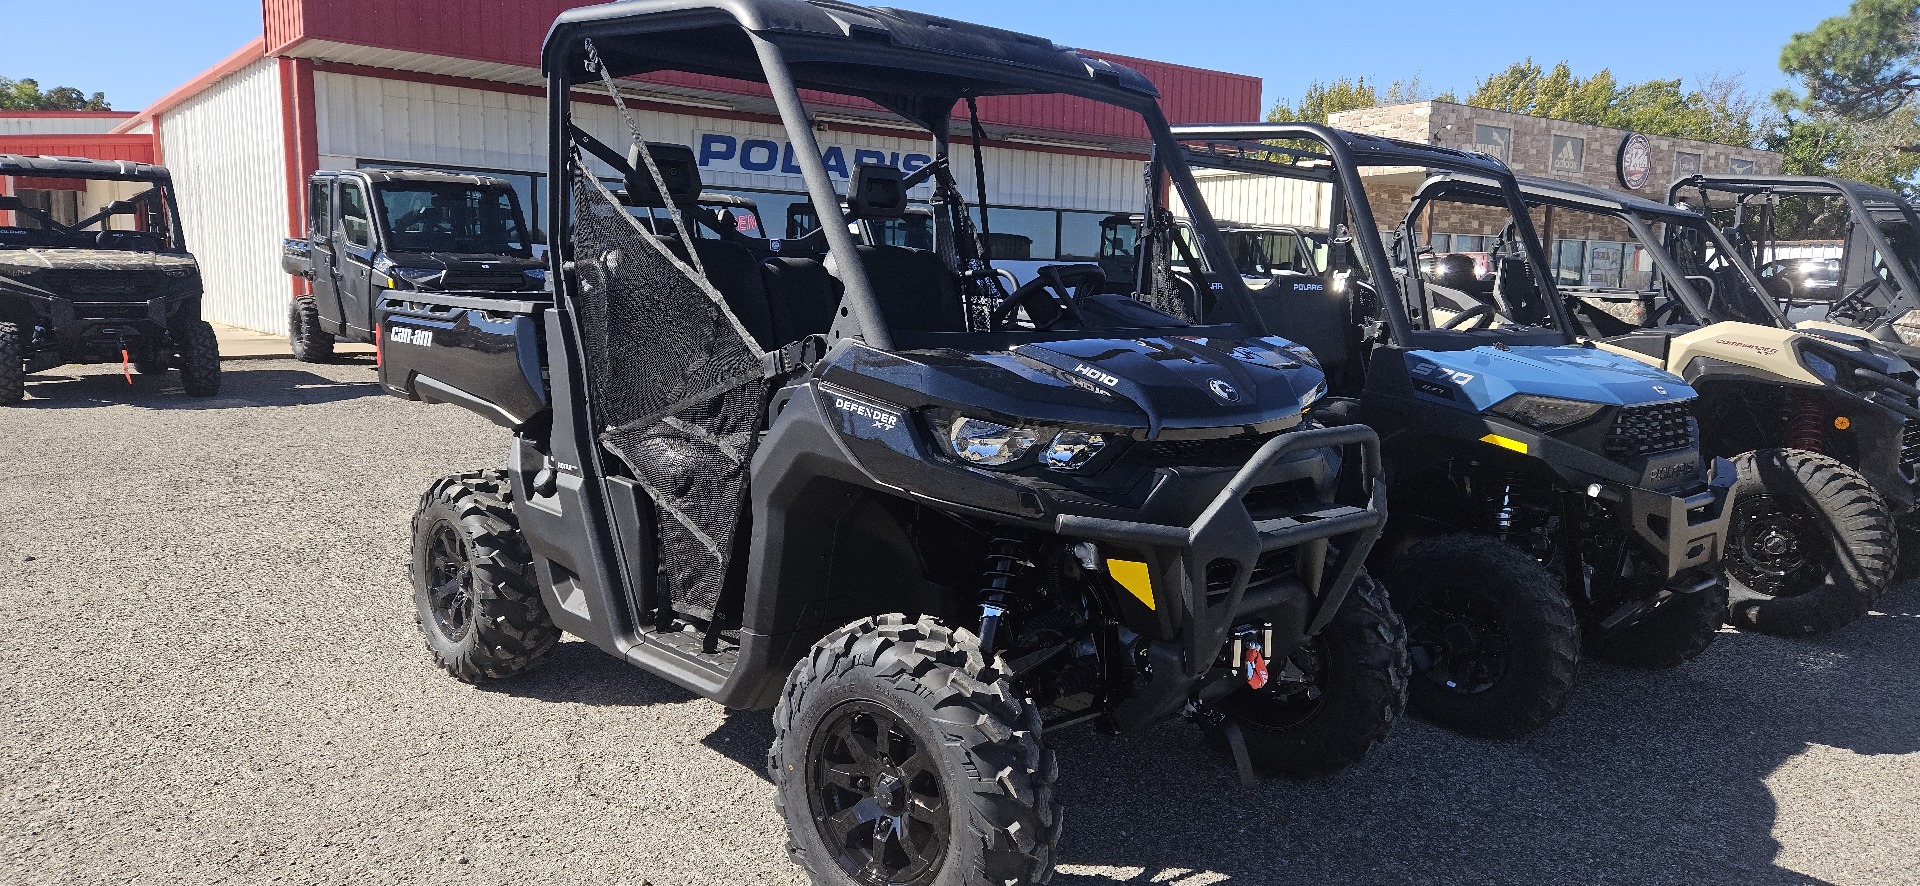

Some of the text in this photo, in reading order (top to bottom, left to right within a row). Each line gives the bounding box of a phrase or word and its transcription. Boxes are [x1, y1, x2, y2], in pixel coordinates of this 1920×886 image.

[1293, 283, 1323, 291] POLARIS
[390, 326, 433, 348] can-am
[1074, 363, 1119, 387] HD10
[835, 398, 897, 425] DEFENDER
[871, 420, 895, 431] XT
[1650, 461, 1694, 482] POLARIS
